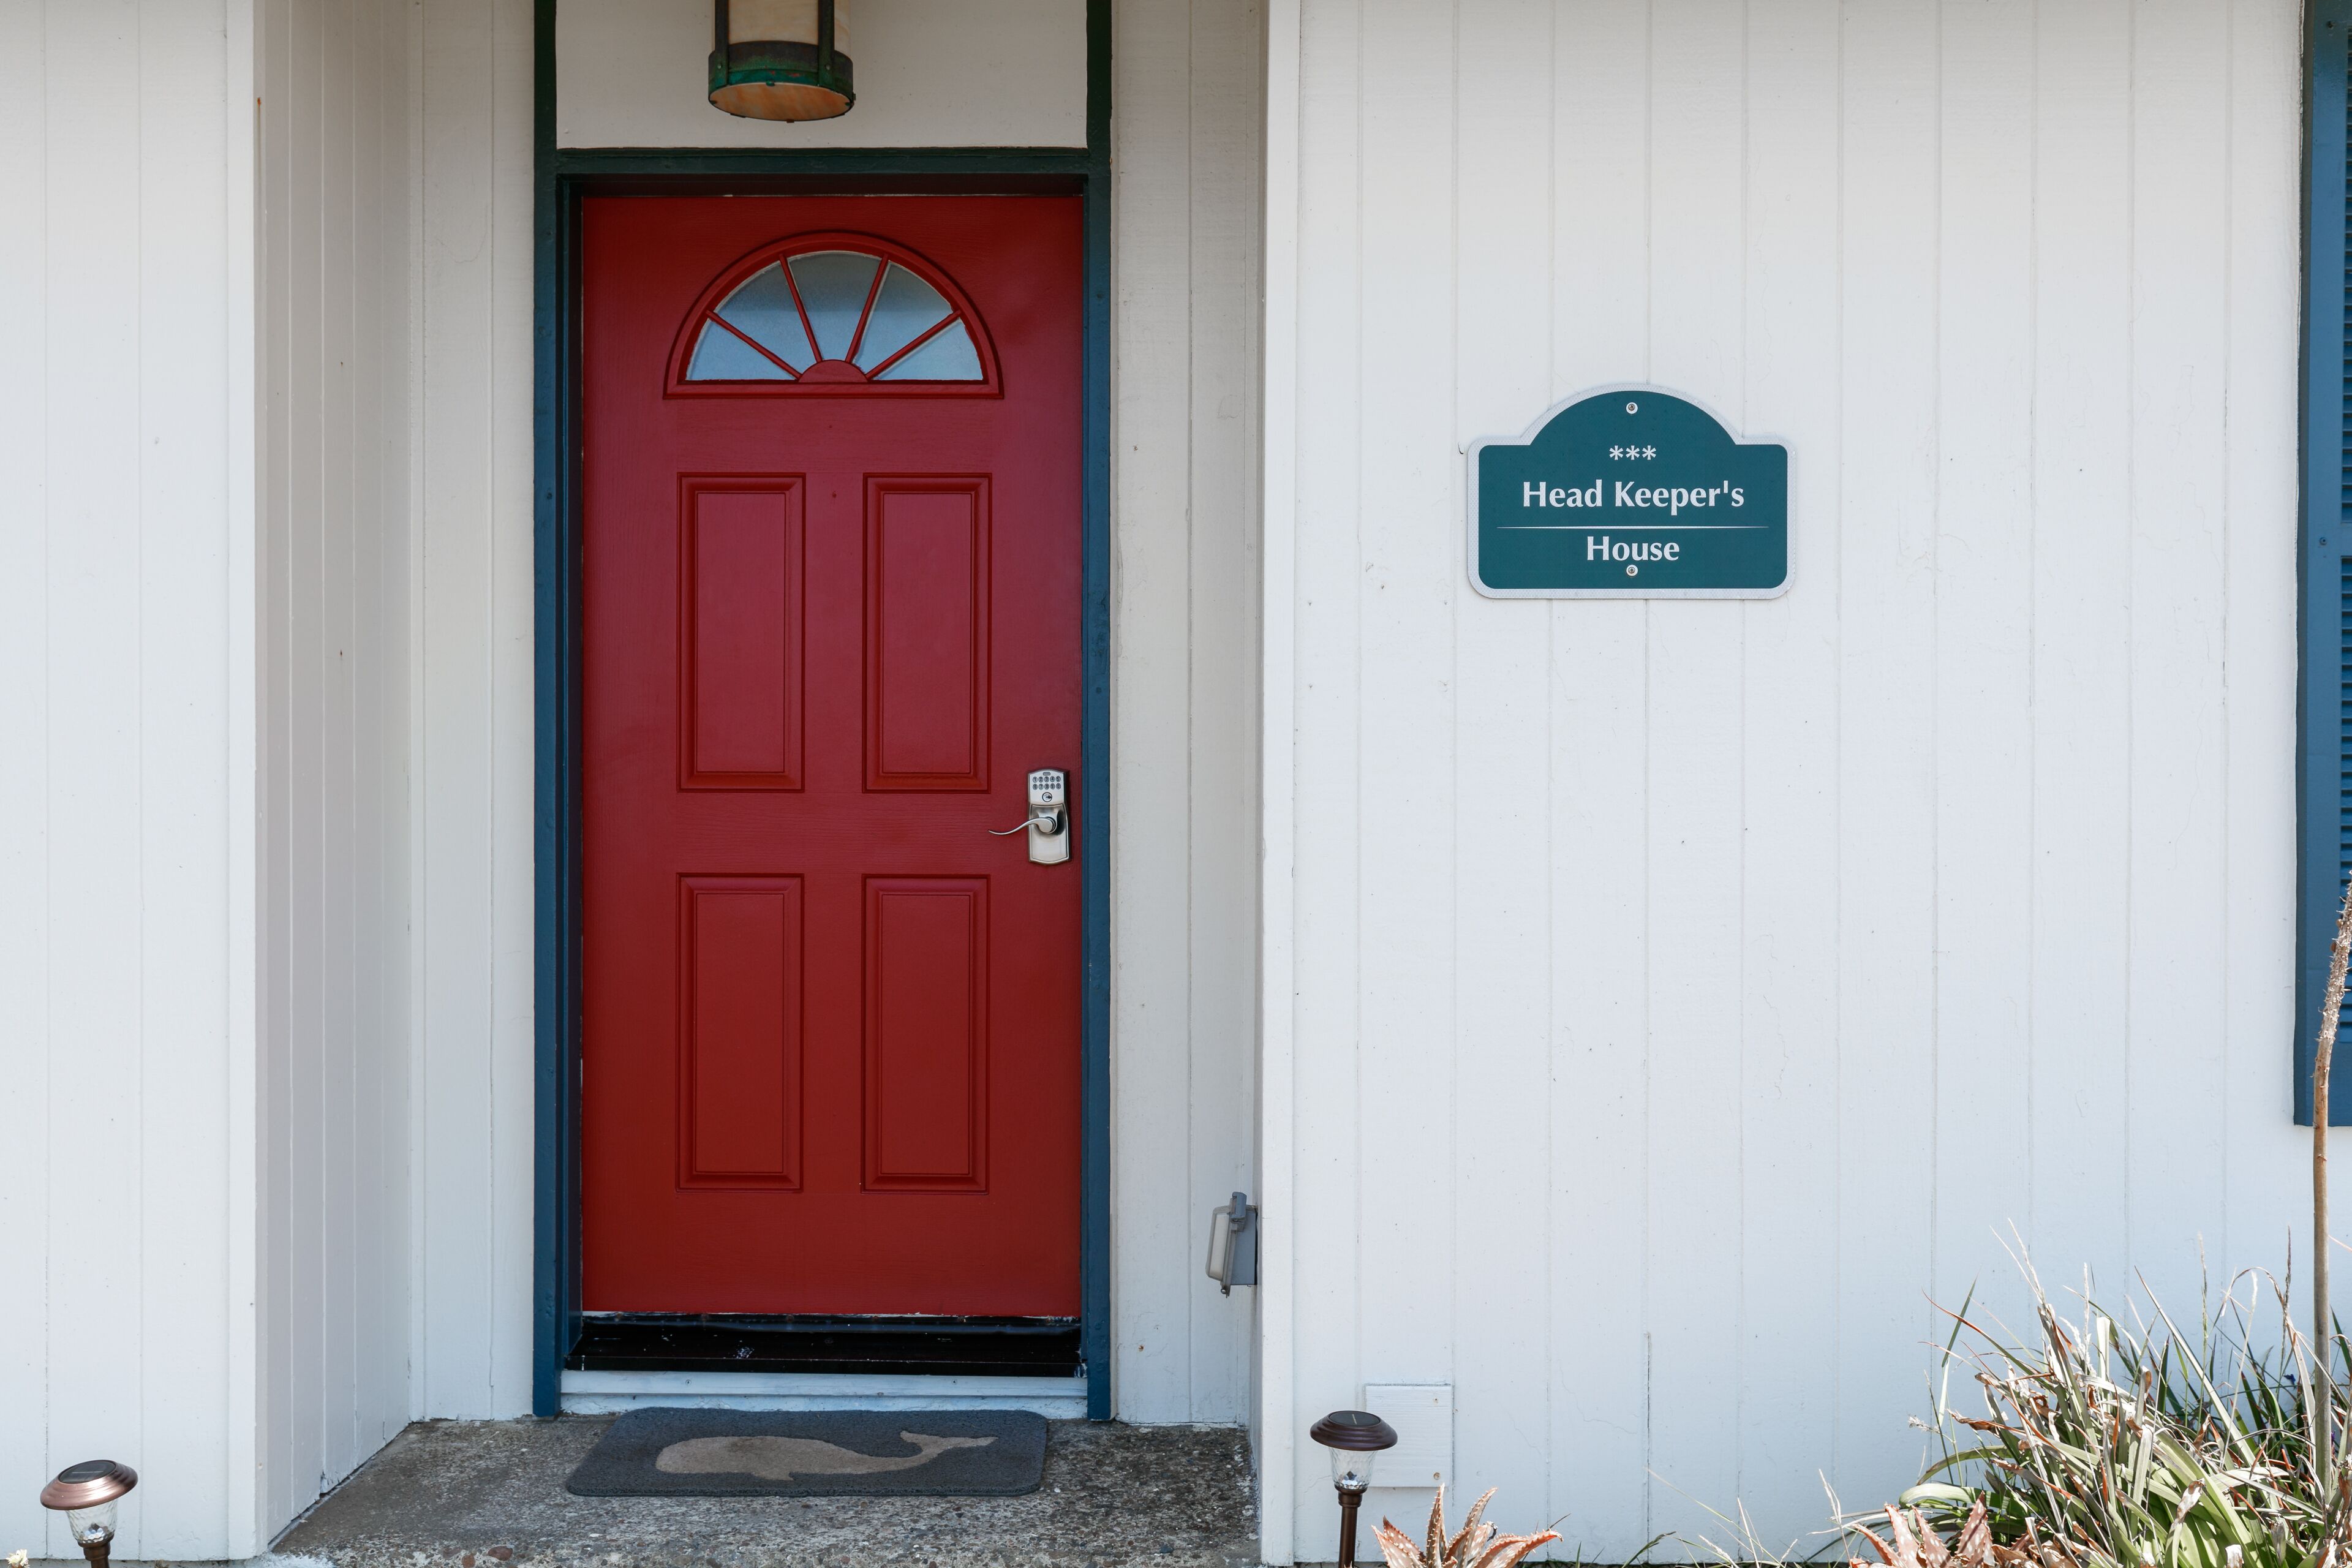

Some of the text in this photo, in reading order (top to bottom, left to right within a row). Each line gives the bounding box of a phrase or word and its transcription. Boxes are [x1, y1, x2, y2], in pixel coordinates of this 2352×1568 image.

[1523, 479, 1745, 516] Head Keeper's
[1587, 536, 1681, 561] House
